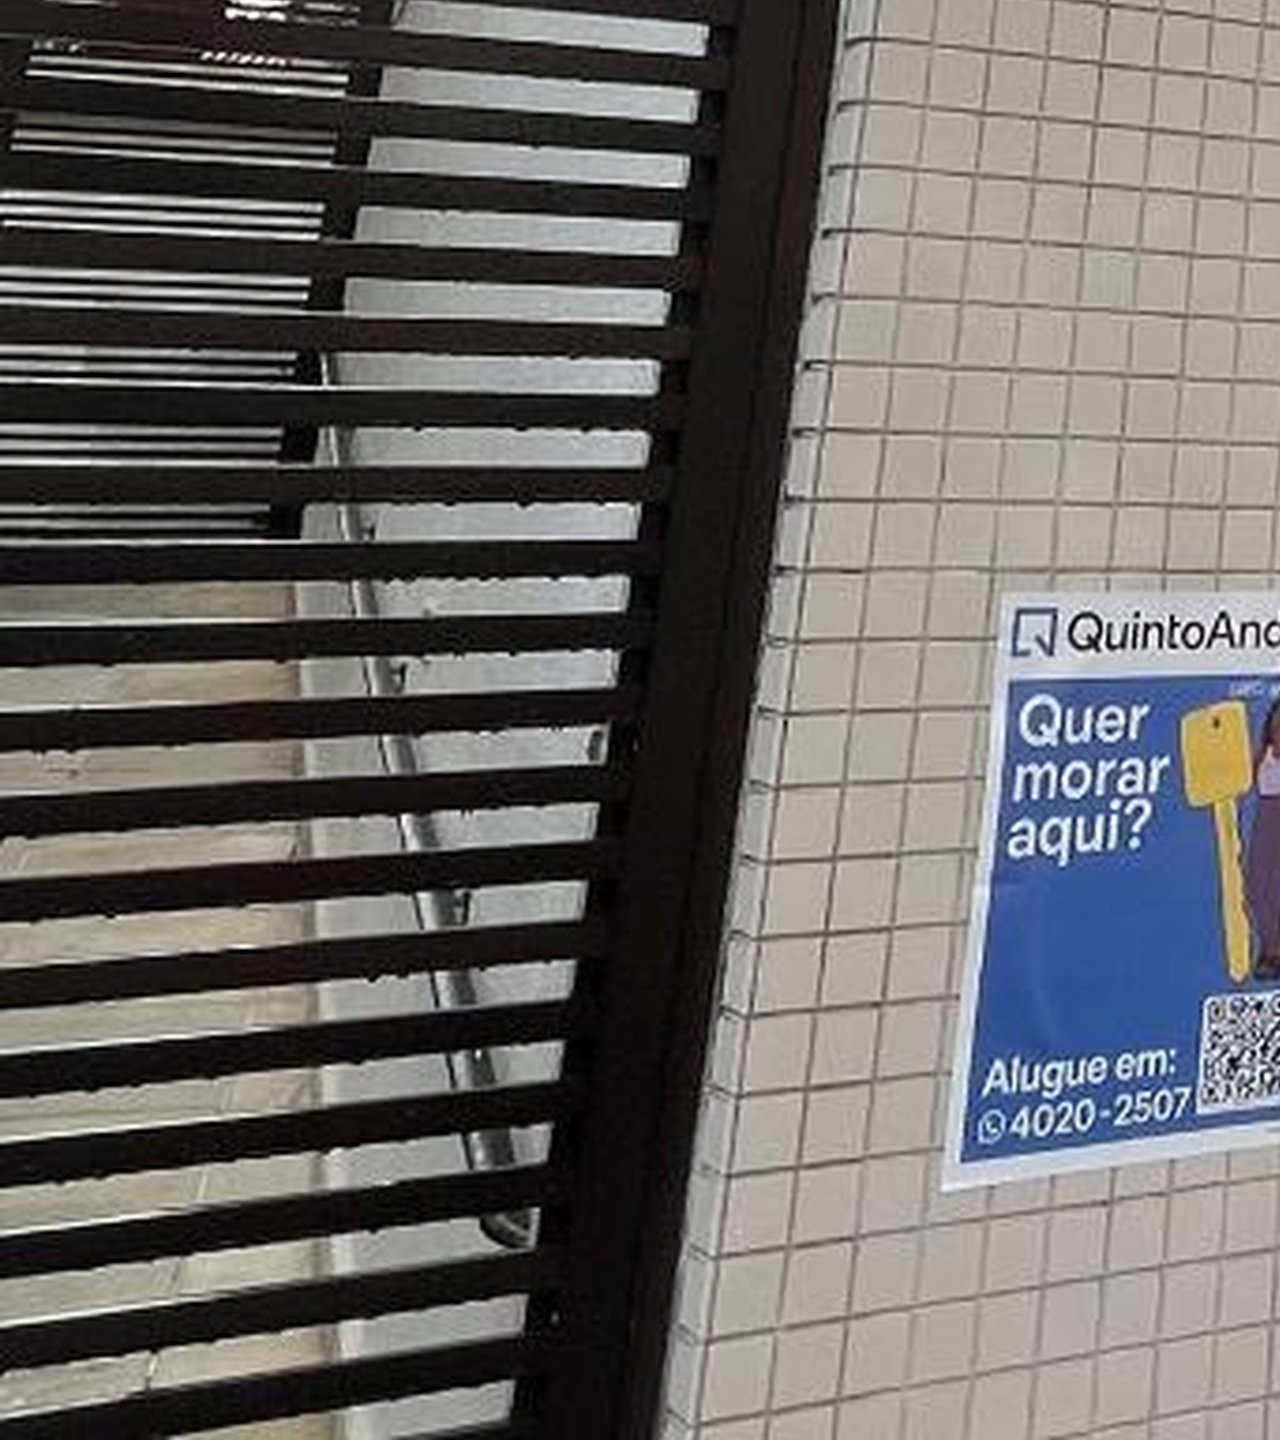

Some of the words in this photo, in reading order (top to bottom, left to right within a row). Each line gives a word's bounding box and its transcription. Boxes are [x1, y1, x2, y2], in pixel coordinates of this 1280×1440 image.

[1017, 693, 1150, 747] Quer
[1011, 755, 1171, 802] morar
[1006, 800, 1152, 866] aqui?
[980, 1056, 1109, 1099] Alugue
[1113, 1048, 1177, 1081] em:
[1009, 1086, 1192, 1139] 4020-2507
